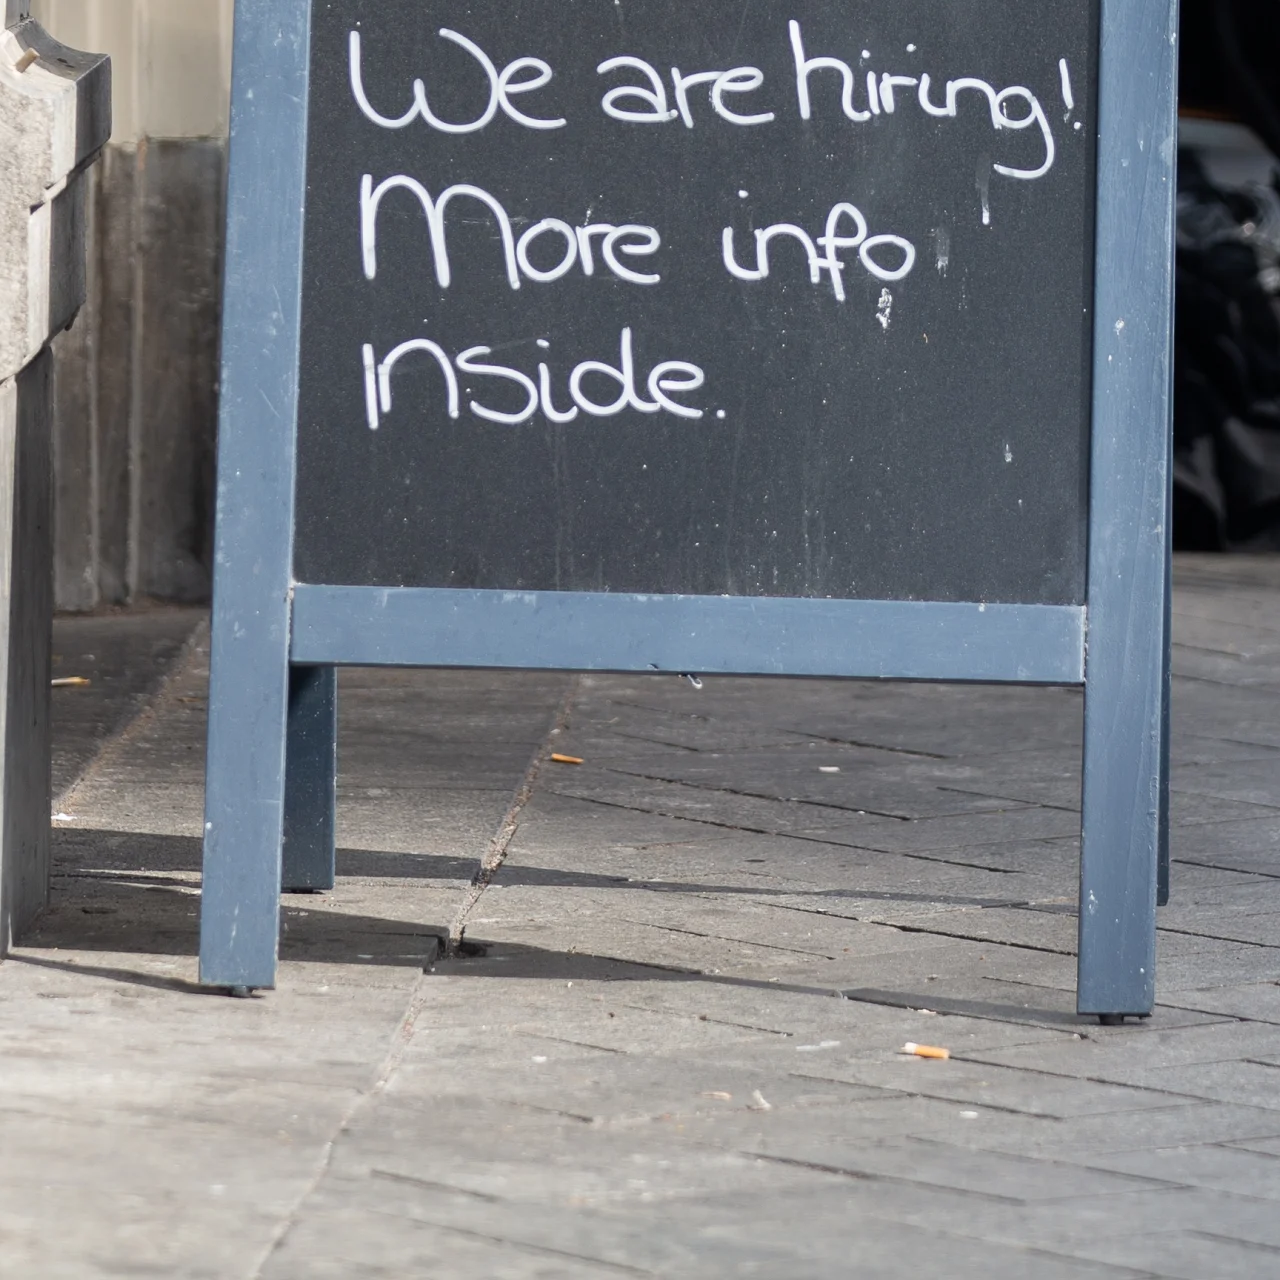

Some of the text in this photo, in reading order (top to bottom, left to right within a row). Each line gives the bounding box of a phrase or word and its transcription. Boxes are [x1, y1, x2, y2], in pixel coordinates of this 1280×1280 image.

[350, 20, 1081, 179] We are hiring!
[360, 174, 915, 301] More info
